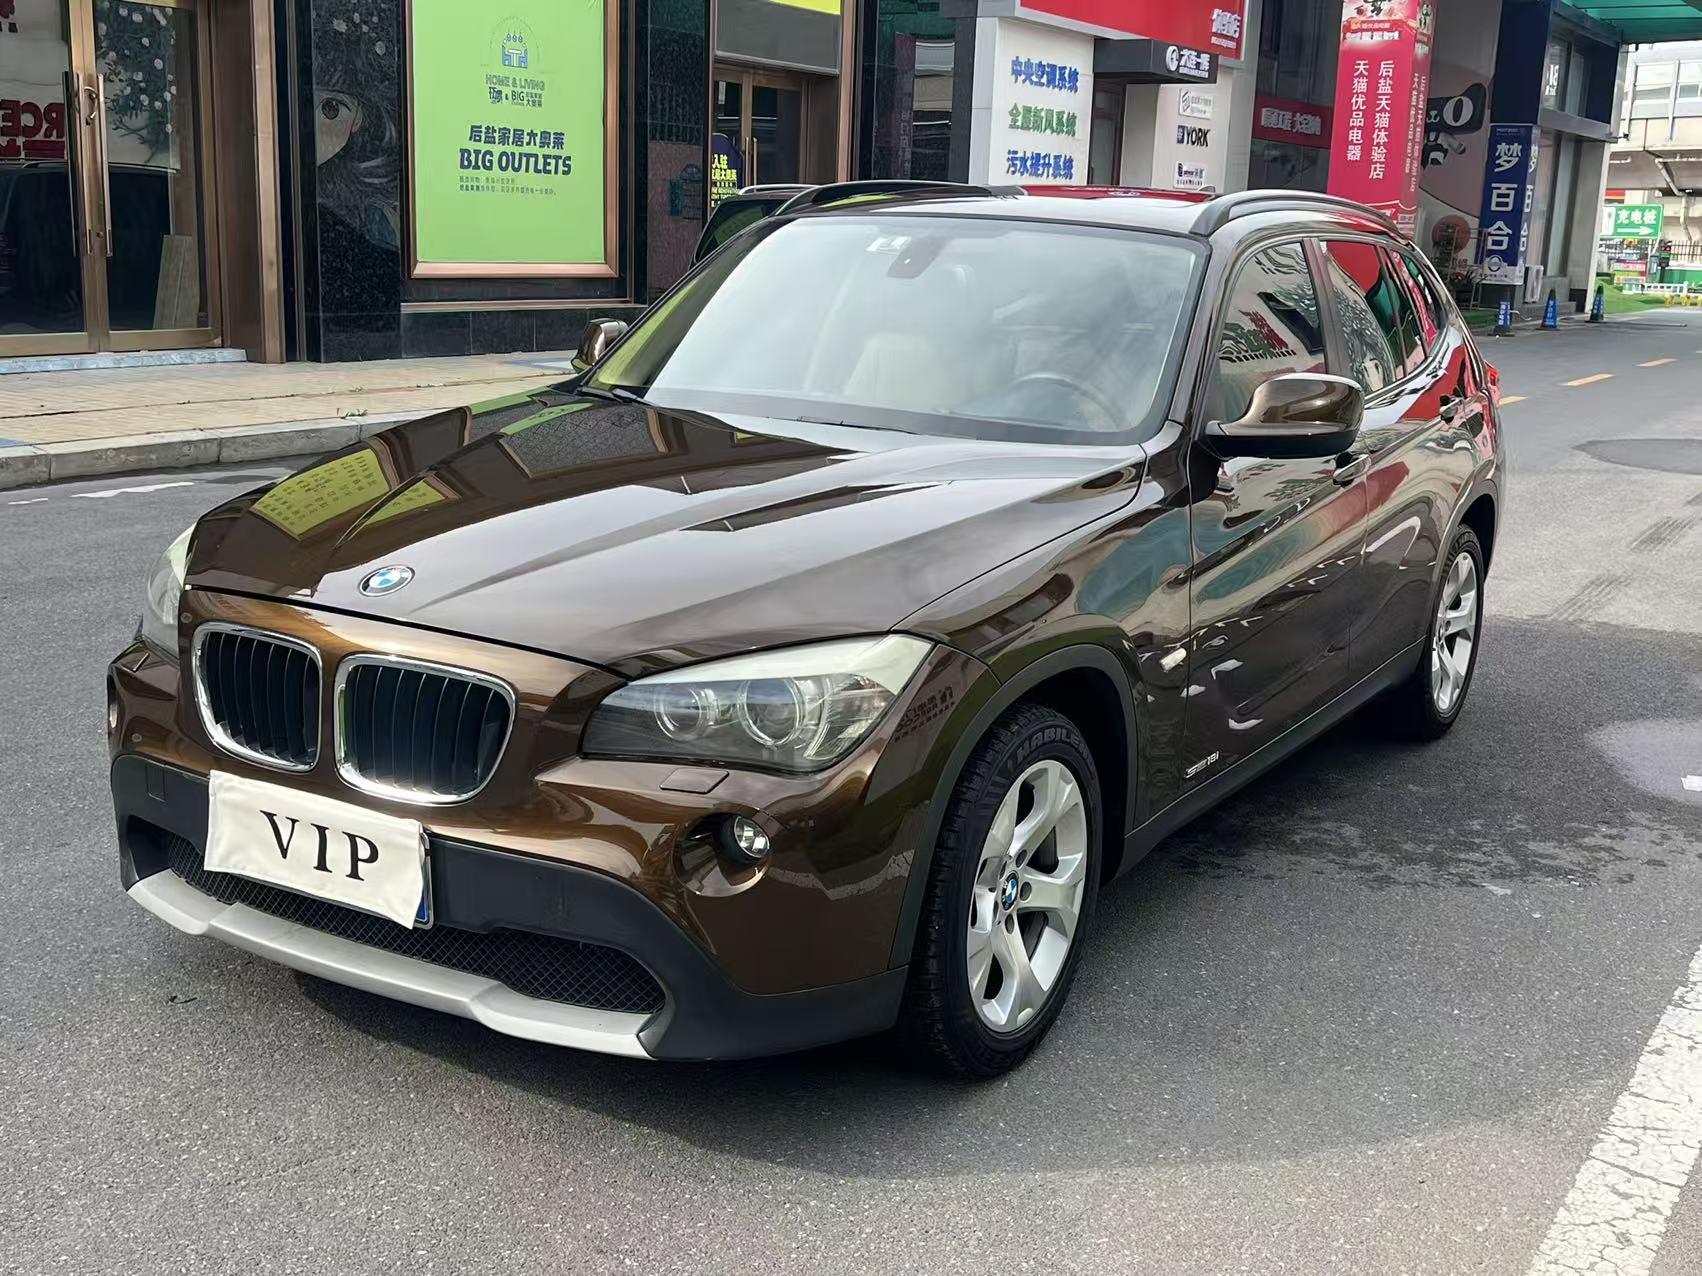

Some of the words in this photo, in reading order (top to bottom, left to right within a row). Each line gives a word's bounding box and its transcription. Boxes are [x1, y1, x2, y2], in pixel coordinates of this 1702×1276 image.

[1010, 56, 1079, 93] 中央空调系统
[1346, 60, 1369, 161] 天猫优品电器
[1369, 60, 1395, 180] 后盐天猫体验店
[469, 124, 565, 150] 后盐家居大奥莱
[1186, 125, 1211, 147] YORK
[459, 148, 494, 171] BIG
[497, 150, 572, 176] OUTLETS
[1006, 149, 1074, 180] 污水提升系统
[1487, 142, 1522, 251] 梦百合
[1617, 209, 1656, 225] 充电桩
[259, 809, 379, 882] VIP
